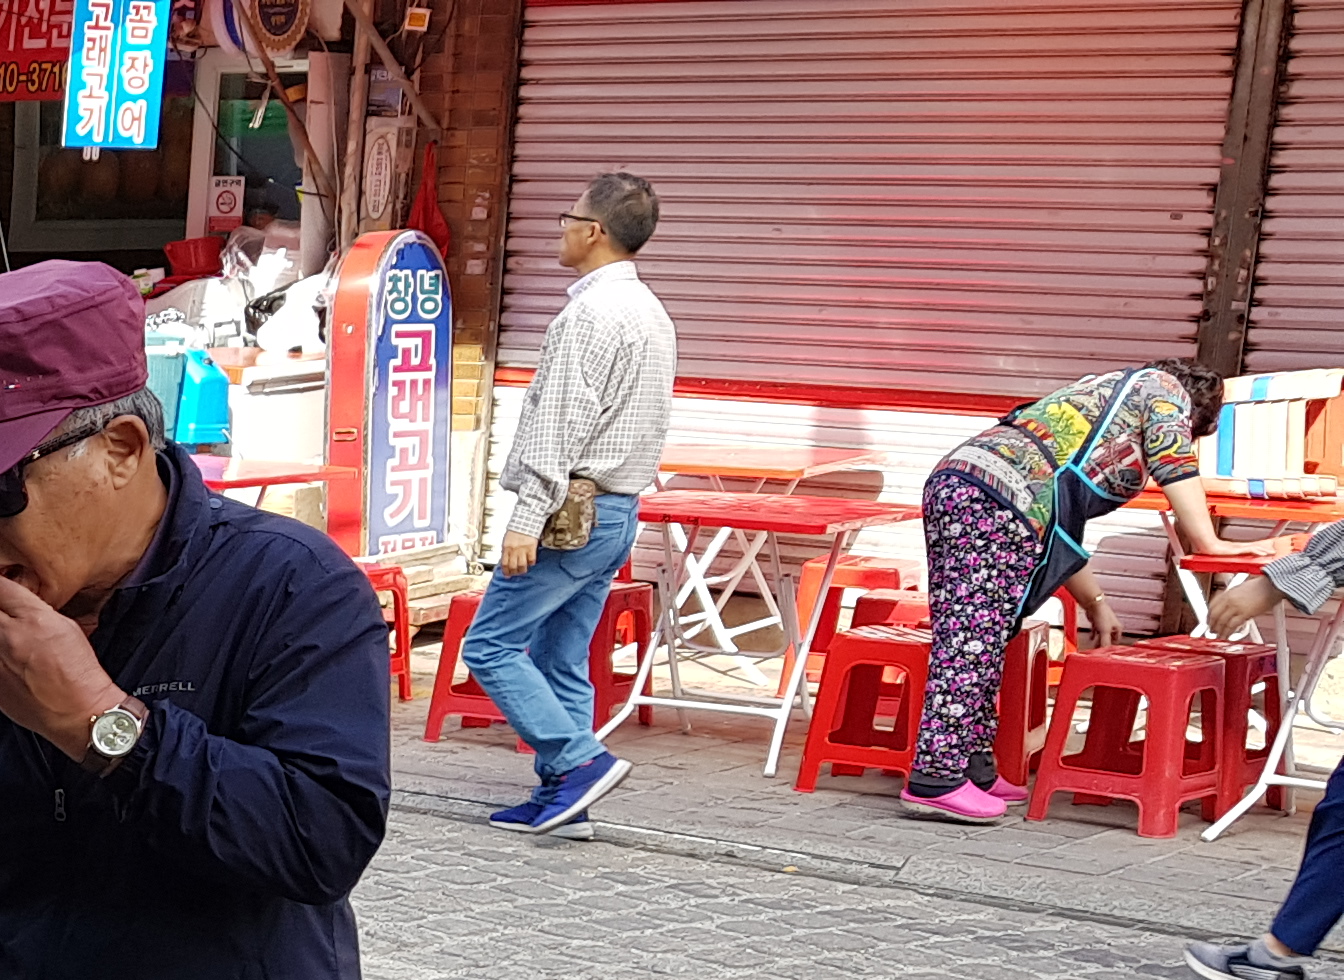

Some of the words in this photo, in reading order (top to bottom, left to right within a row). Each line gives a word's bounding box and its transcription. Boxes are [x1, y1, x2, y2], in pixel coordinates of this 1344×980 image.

[80, 2, 112, 138] 고래고기
[121, 4, 153, 138] 꼼장어
[387, 271, 442, 318] 창녕
[386, 328, 435, 525] 고래고기
